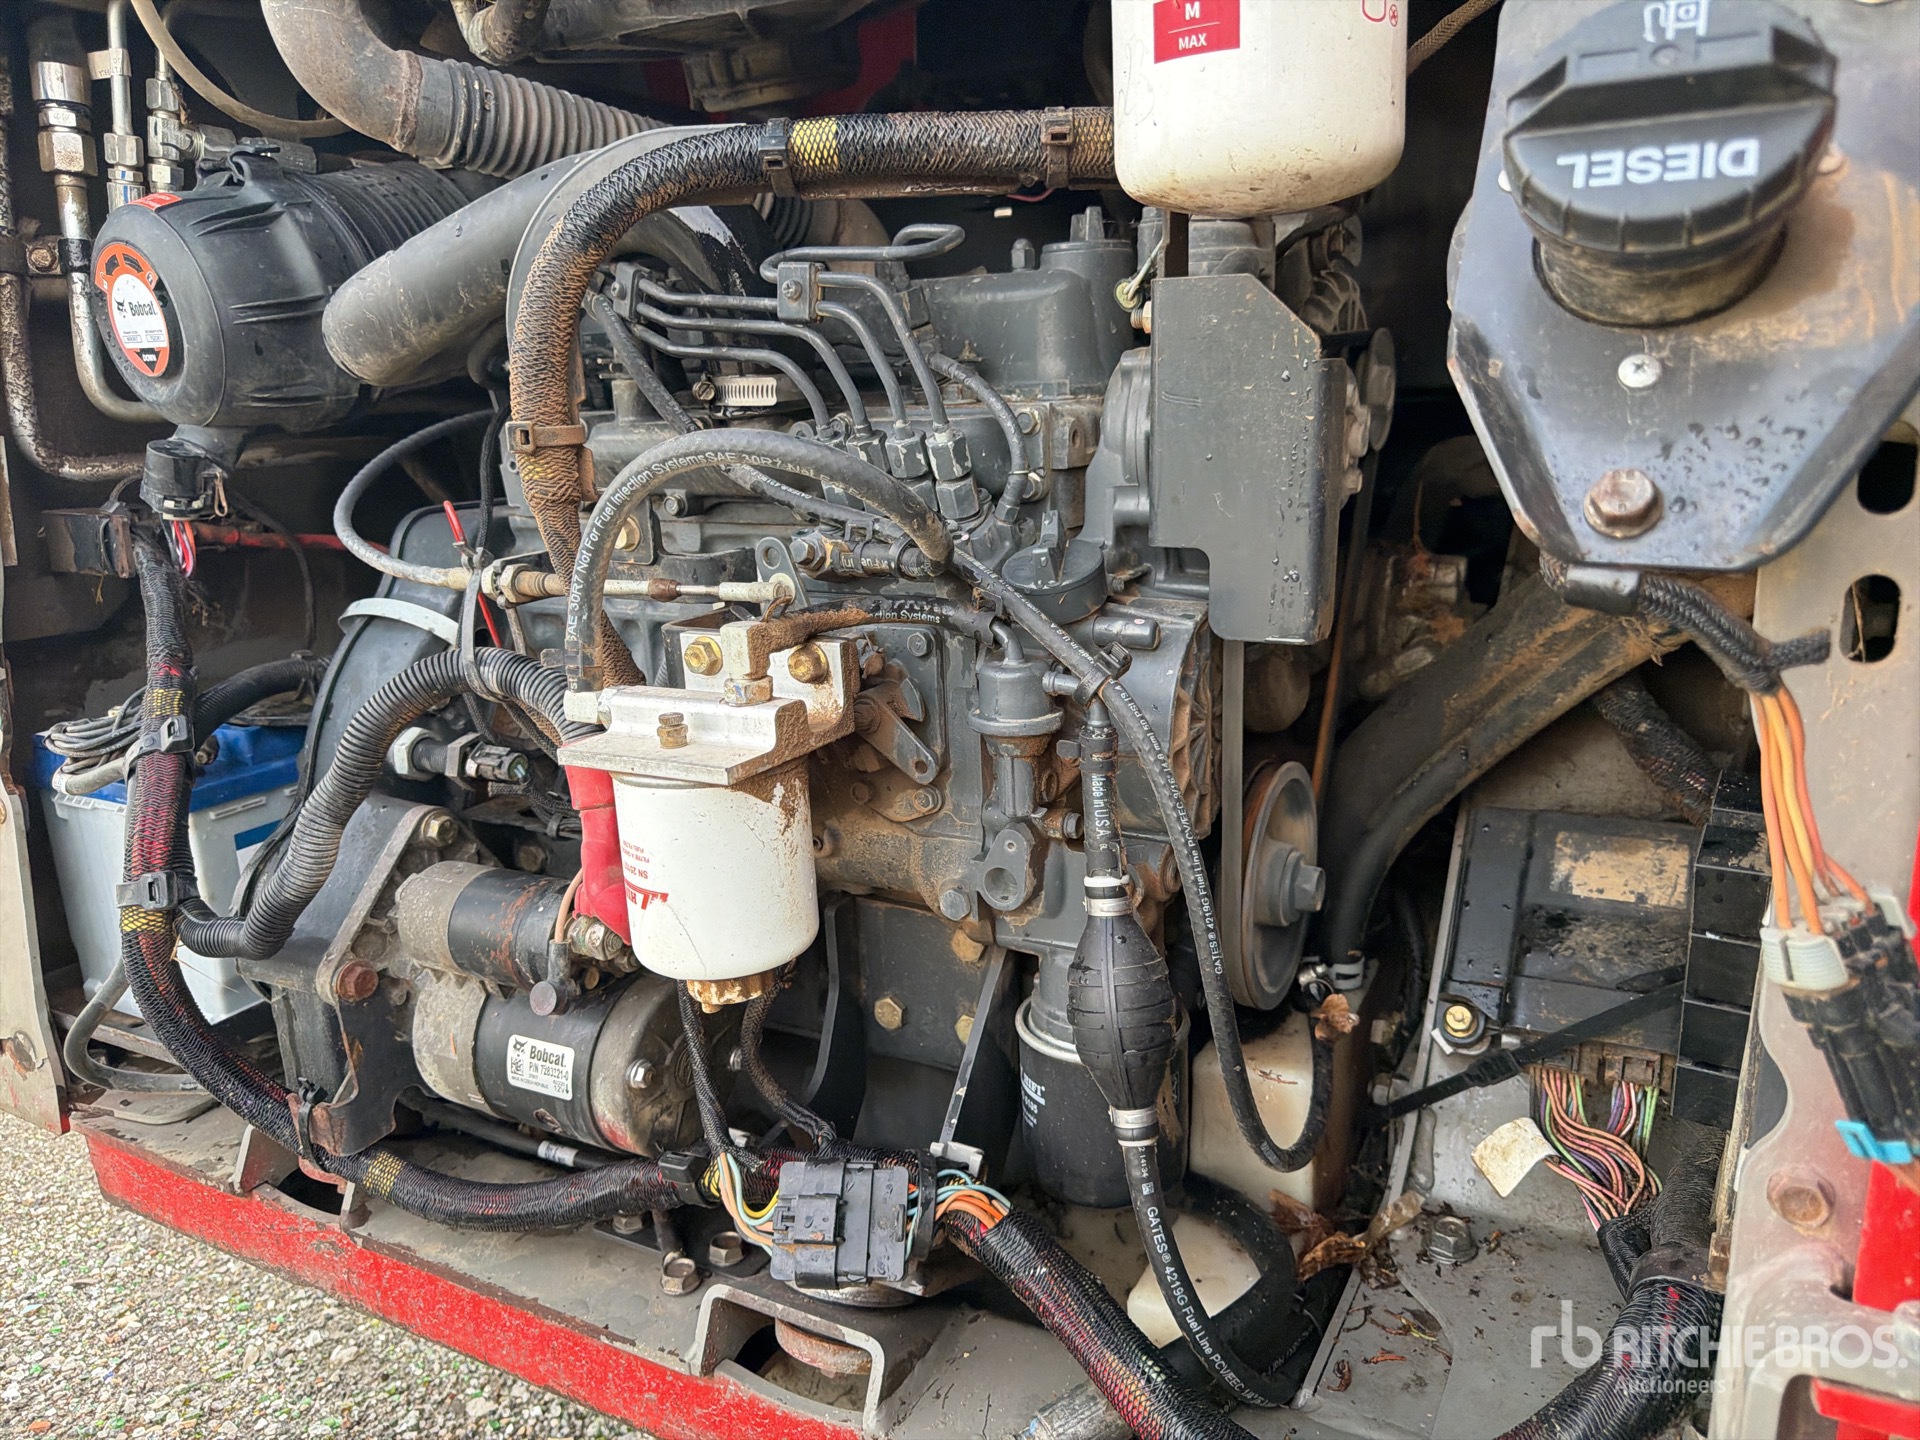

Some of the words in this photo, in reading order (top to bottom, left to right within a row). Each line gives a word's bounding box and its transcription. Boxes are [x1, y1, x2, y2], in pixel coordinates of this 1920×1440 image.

[1177, 32, 1208, 51] MAX
[1556, 138, 1761, 190] DIESEL
[128, 301, 157, 317] Bobcat
[613, 468, 655, 507] Injection
[594, 496, 618, 530] Fuel
[584, 529, 601, 551] For
[576, 547, 603, 575] Not
[568, 576, 585, 611] 30R7
[900, 609, 941, 624] Systems
[1127, 702, 1143, 718] PSI
[1139, 718, 1150, 731] 50
[1091, 774, 1107, 797] Made
[1093, 799, 1108, 808] in
[1094, 808, 1112, 840] U.S.A.
[1176, 802, 1197, 848] PCV/EEC
[1192, 848, 1203, 871] Line
[638, 868, 649, 880] SN
[1195, 872, 1208, 896] Fuel
[1200, 899, 1215, 930] 4219G
[528, 1061, 540, 1074] P/N
[529, 1044, 565, 1068] Bobcat
[1164, 1265, 1189, 1306] 4219G
[1181, 1304, 1202, 1333] Fuel
[1195, 1329, 1214, 1356] Line
[1209, 1353, 1246, 1392] PCV/EEC
